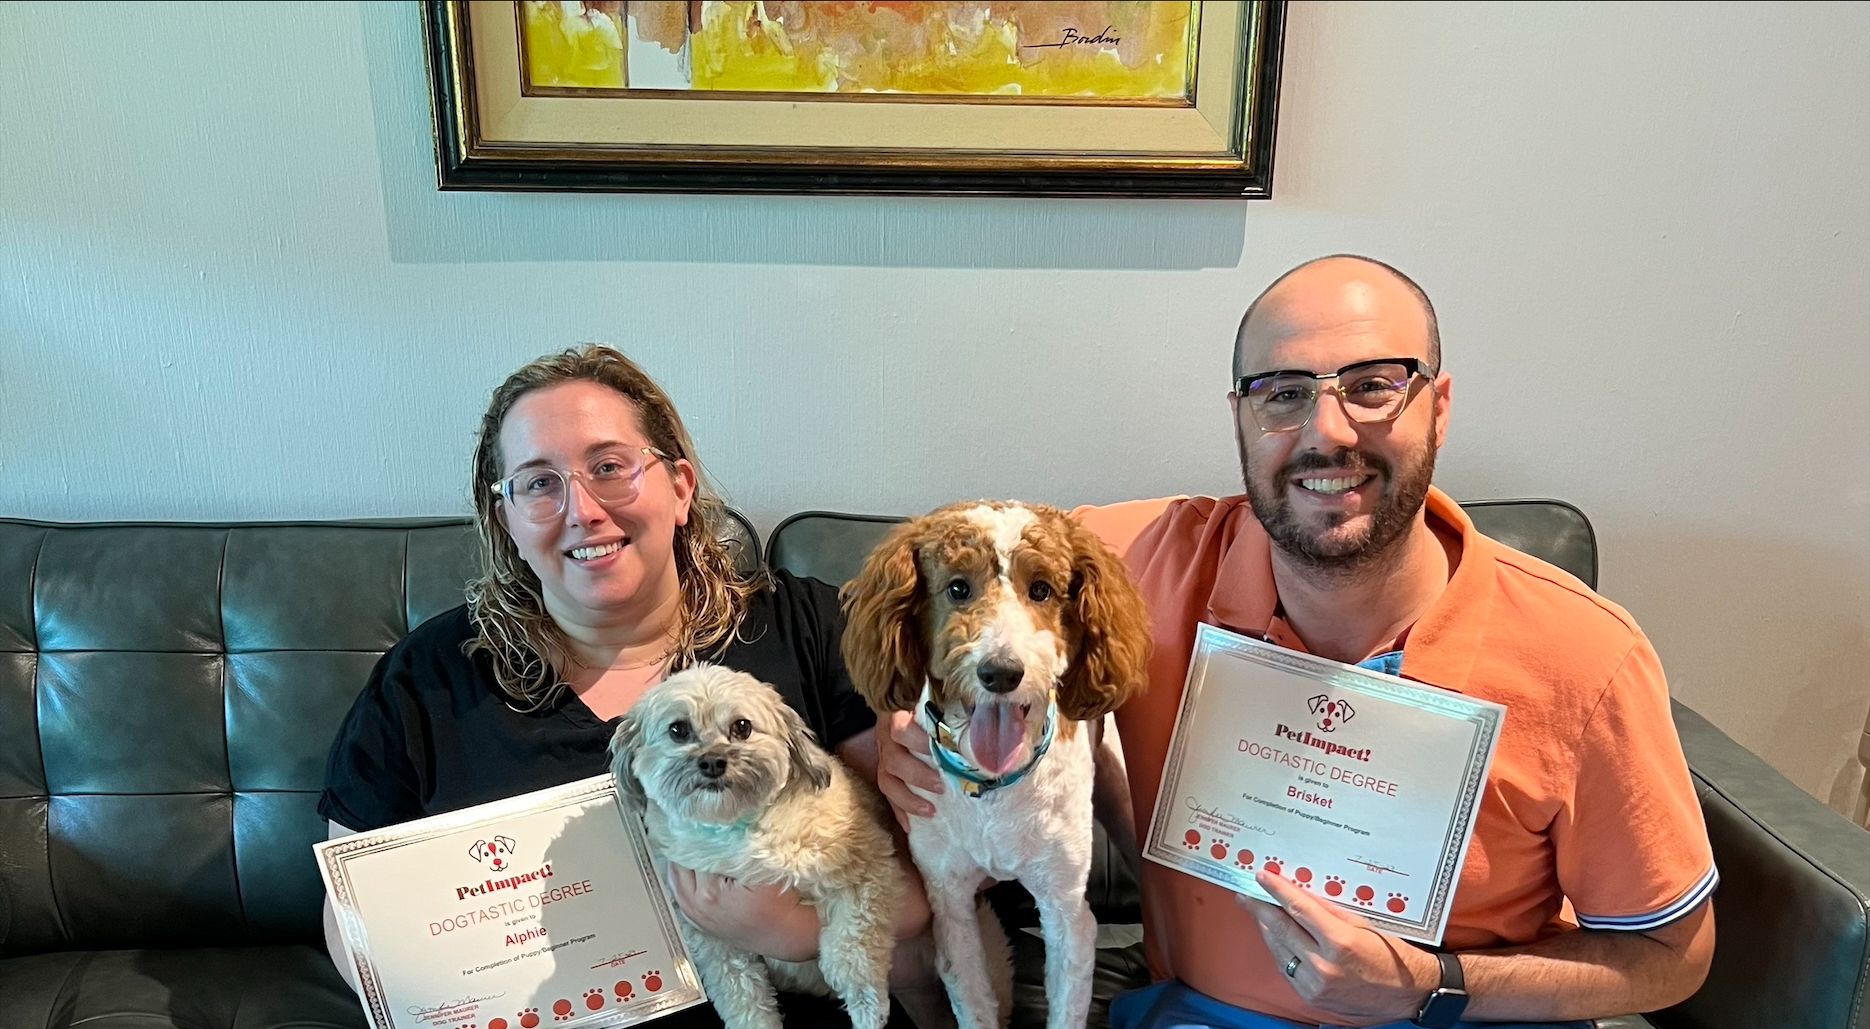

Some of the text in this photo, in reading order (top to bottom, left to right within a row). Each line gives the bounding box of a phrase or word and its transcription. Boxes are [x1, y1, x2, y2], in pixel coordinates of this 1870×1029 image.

[1274, 723, 1372, 762] PetImpact!
[1237, 739, 1399, 797] DOGTASTIC DEGREE
[1304, 778, 1322, 787] given
[1286, 785, 1333, 809] Brisket
[1242, 792, 1252, 800] For
[1253, 796, 1287, 812] Completion
[1294, 809, 1343, 829] Puppy/Beginner
[1343, 823, 1371, 837] Program
[1211, 827, 1234, 838] TRAINER
[1366, 866, 1382, 874] DATE
[456, 864, 554, 901] PetImpact!
[429, 879, 594, 936] DOGTASTIC DEGREE
[512, 916, 528, 927] given
[505, 926, 547, 947] Alphie
[462, 968, 474, 976] For
[475, 958, 512, 973] Completion
[520, 941, 569, 959] Puppy/Beginner
[570, 933, 597, 946] Program
[610, 960, 626, 968] DATE
[448, 1013, 476, 1023] TRAINER
[453, 1004, 480, 1014] MAURER
